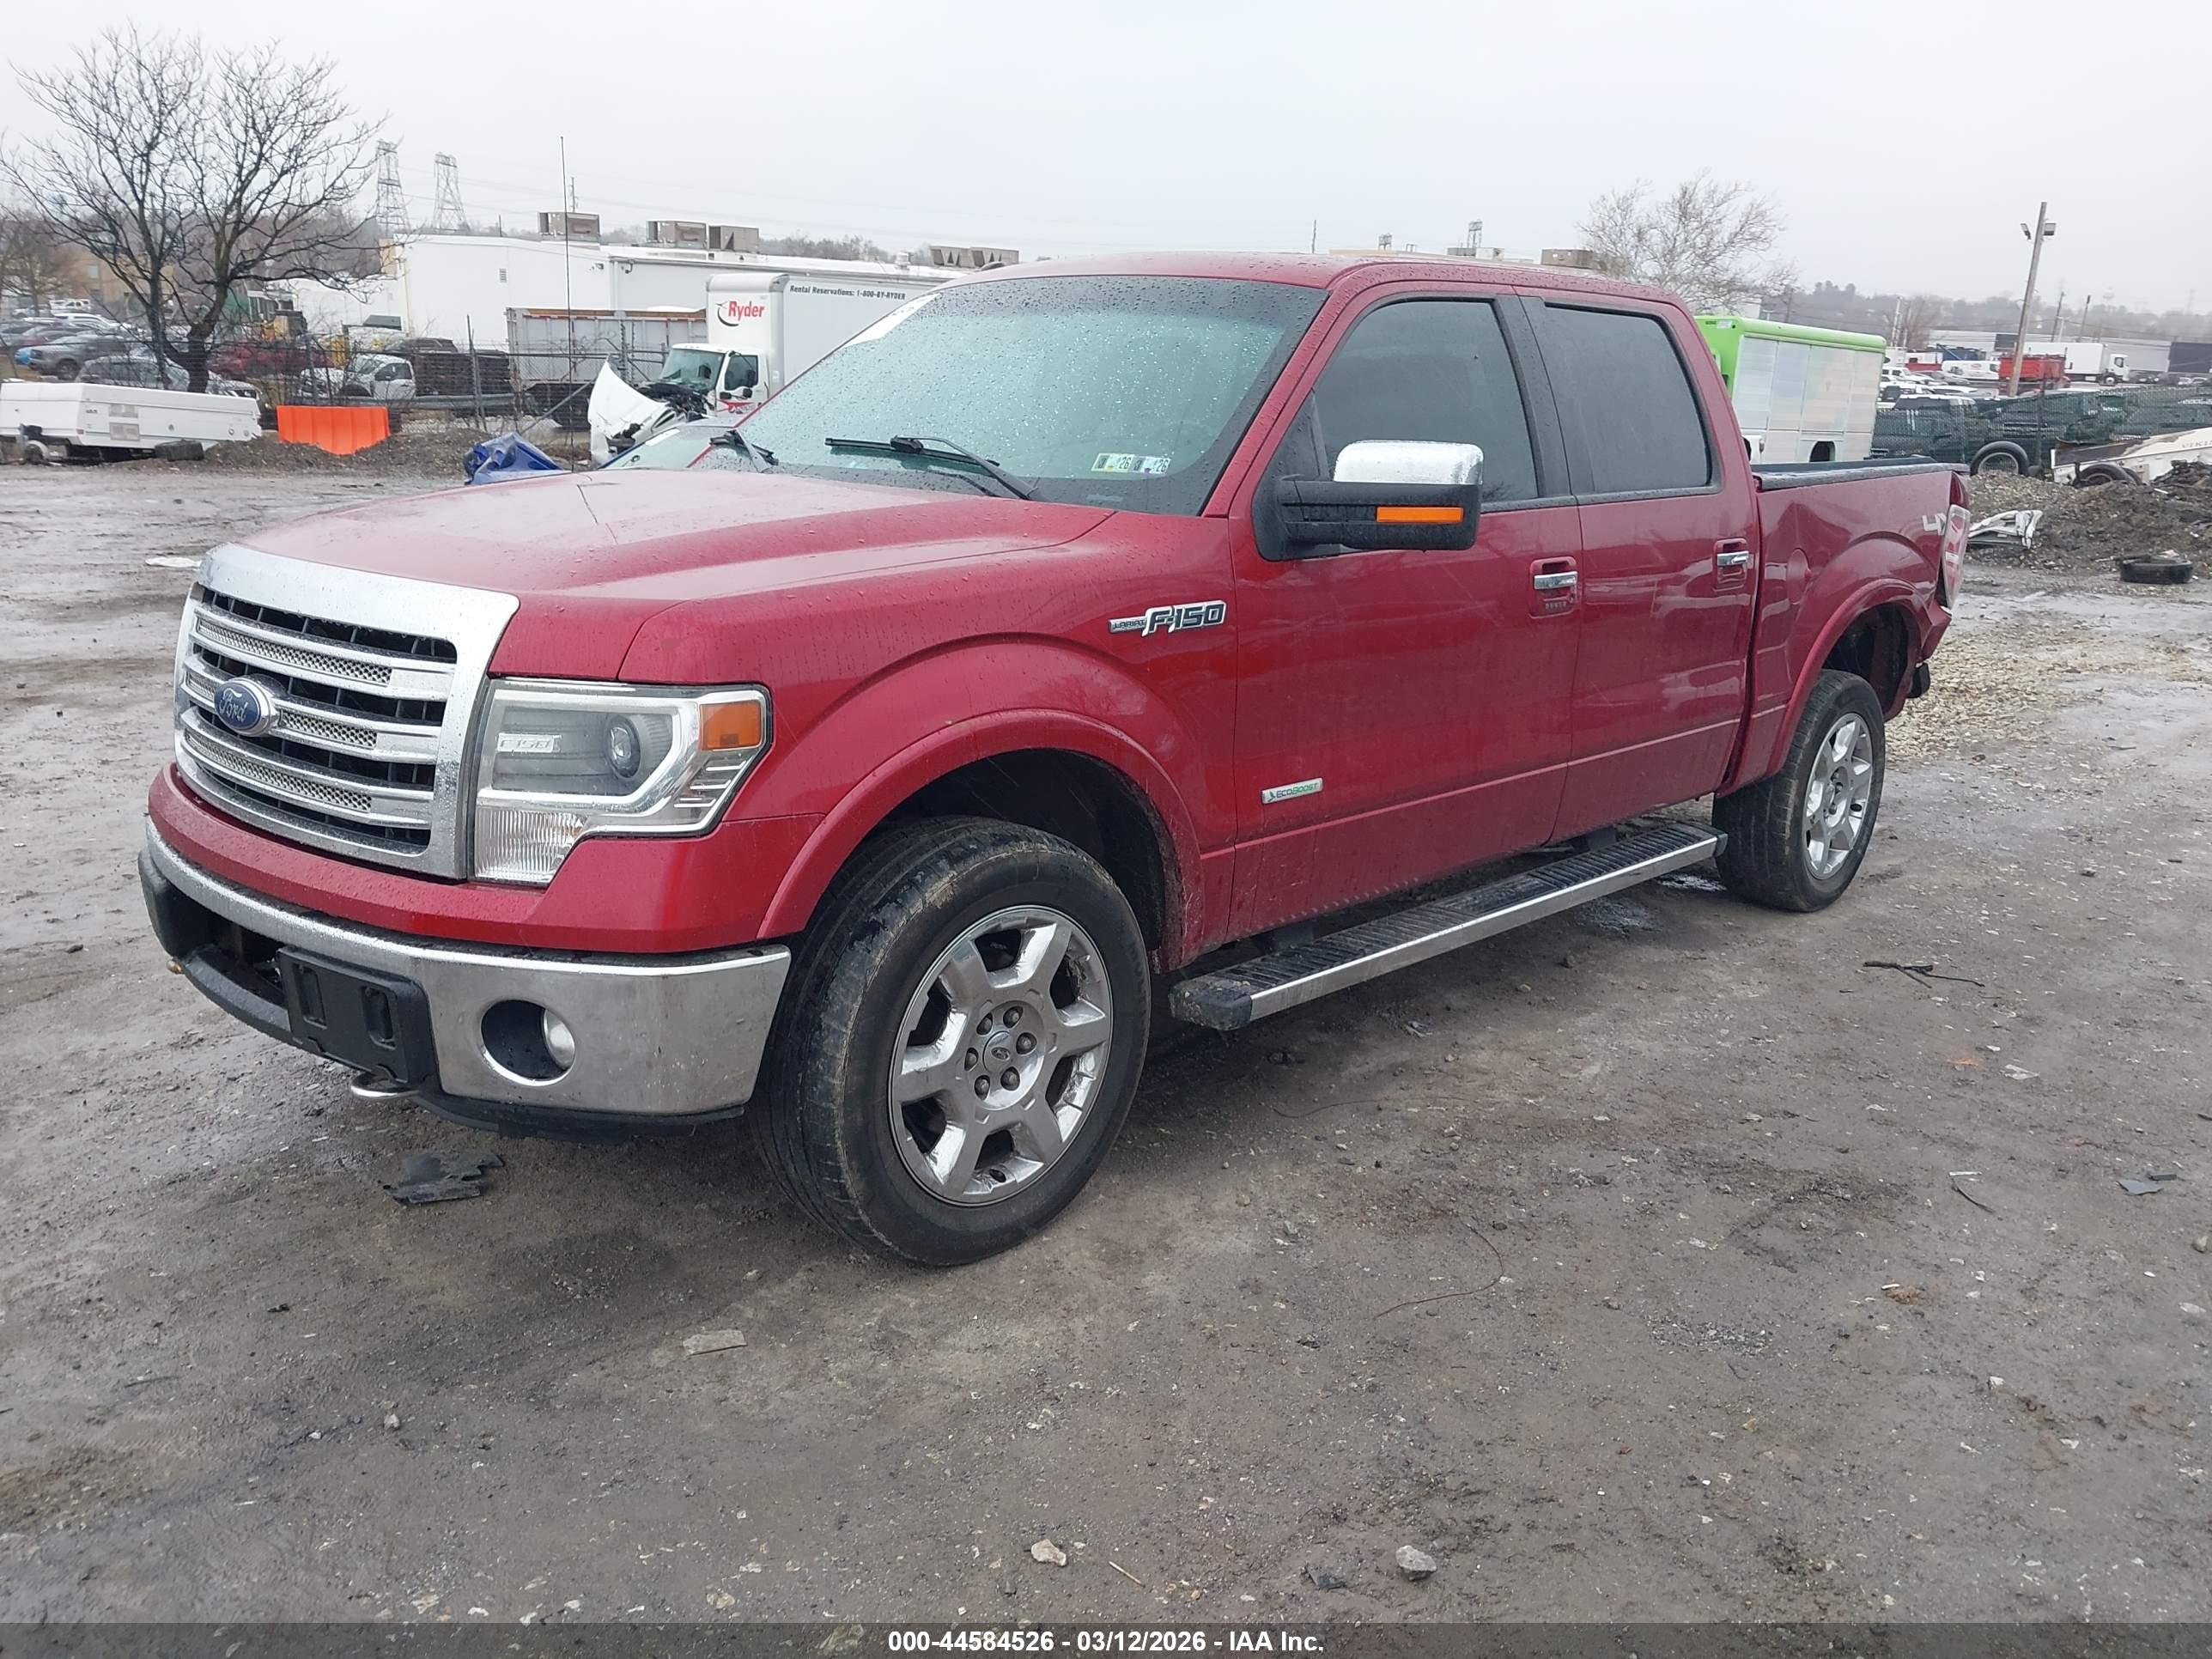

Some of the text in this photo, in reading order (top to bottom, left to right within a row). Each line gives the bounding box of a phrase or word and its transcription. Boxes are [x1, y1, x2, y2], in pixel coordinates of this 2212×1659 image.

[789, 285, 811, 294] Rental
[811, 286, 855, 297] Reservations:
[728, 301, 765, 321] Ryder
[1113, 601, 1226, 635] LARIAT F-150
[218, 688, 249, 722] Ford
